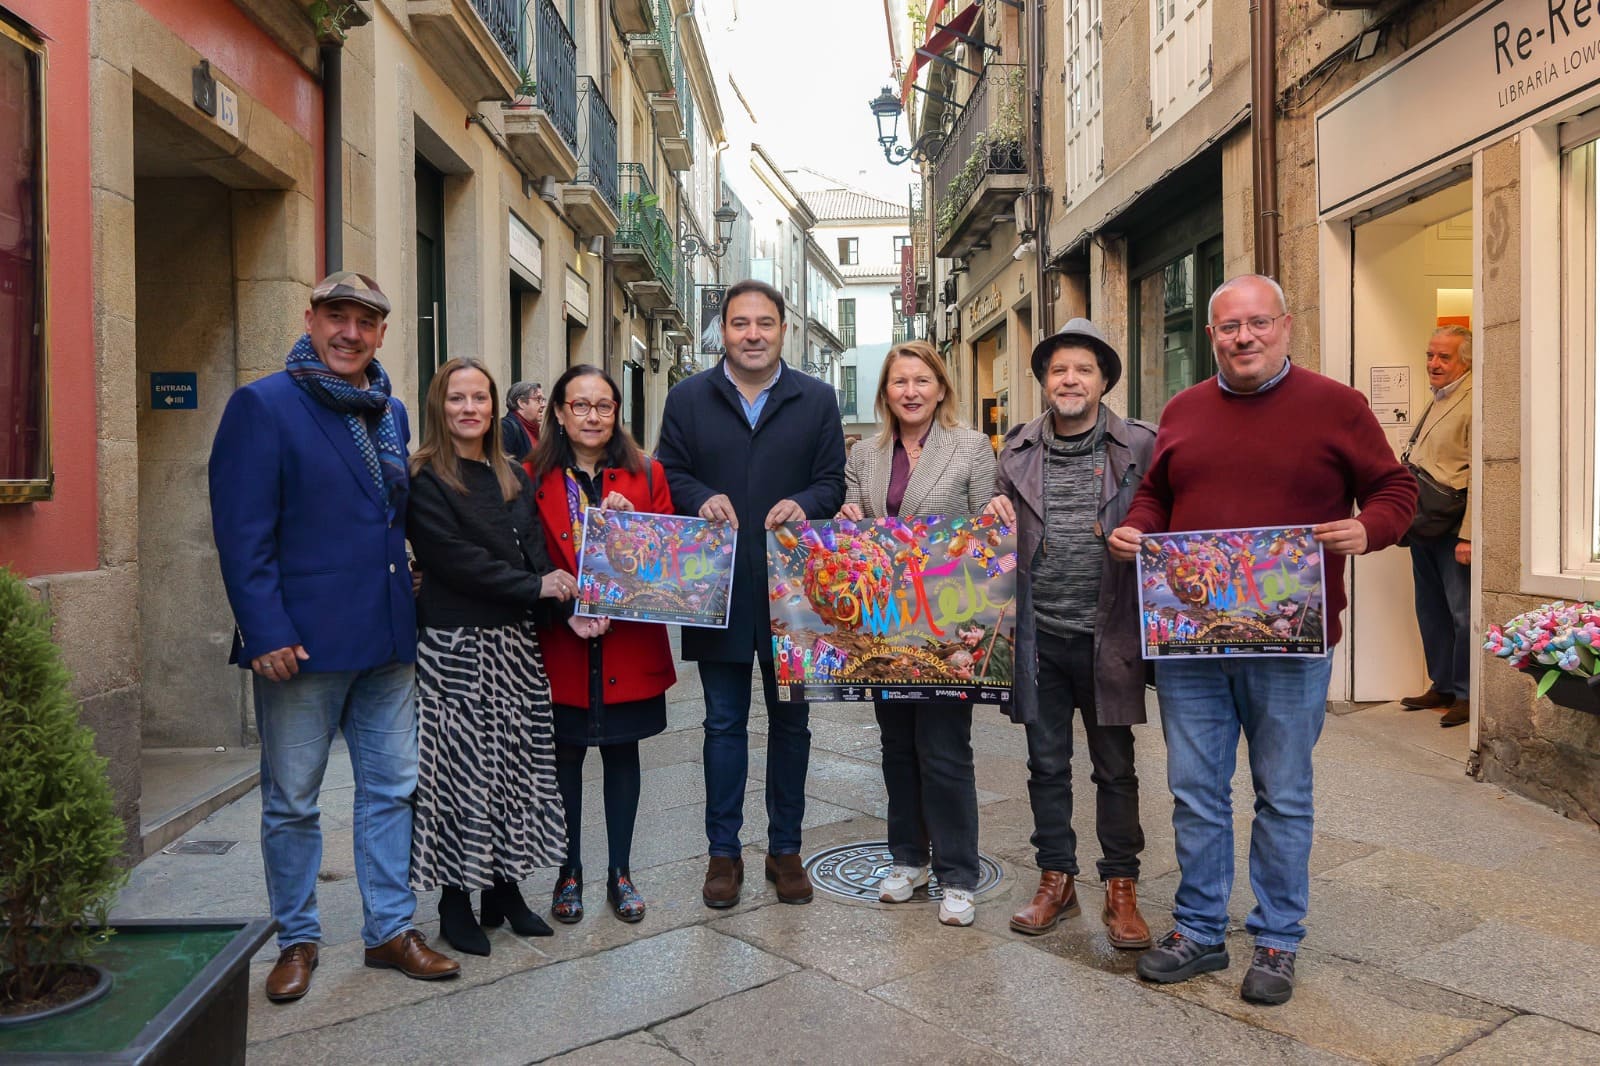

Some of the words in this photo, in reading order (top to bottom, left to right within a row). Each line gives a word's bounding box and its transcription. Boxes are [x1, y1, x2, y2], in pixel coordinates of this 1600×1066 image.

[1493, 0, 1600, 75] Re-Re
[1498, 61, 1559, 108] LIBRARÍA
[1563, 39, 1600, 74] LOW
[904, 247, 912, 315] TROPICAL
[155, 384, 192, 392] ENTRADA
[818, 665, 829, 675] 23
[830, 666, 842, 676] de
[843, 656, 863, 676] abril
[872, 647, 878, 657] 8
[879, 644, 890, 655] de
[891, 645, 914, 654] maio
[914, 648, 926, 659] de
[926, 653, 948, 673] 2026
